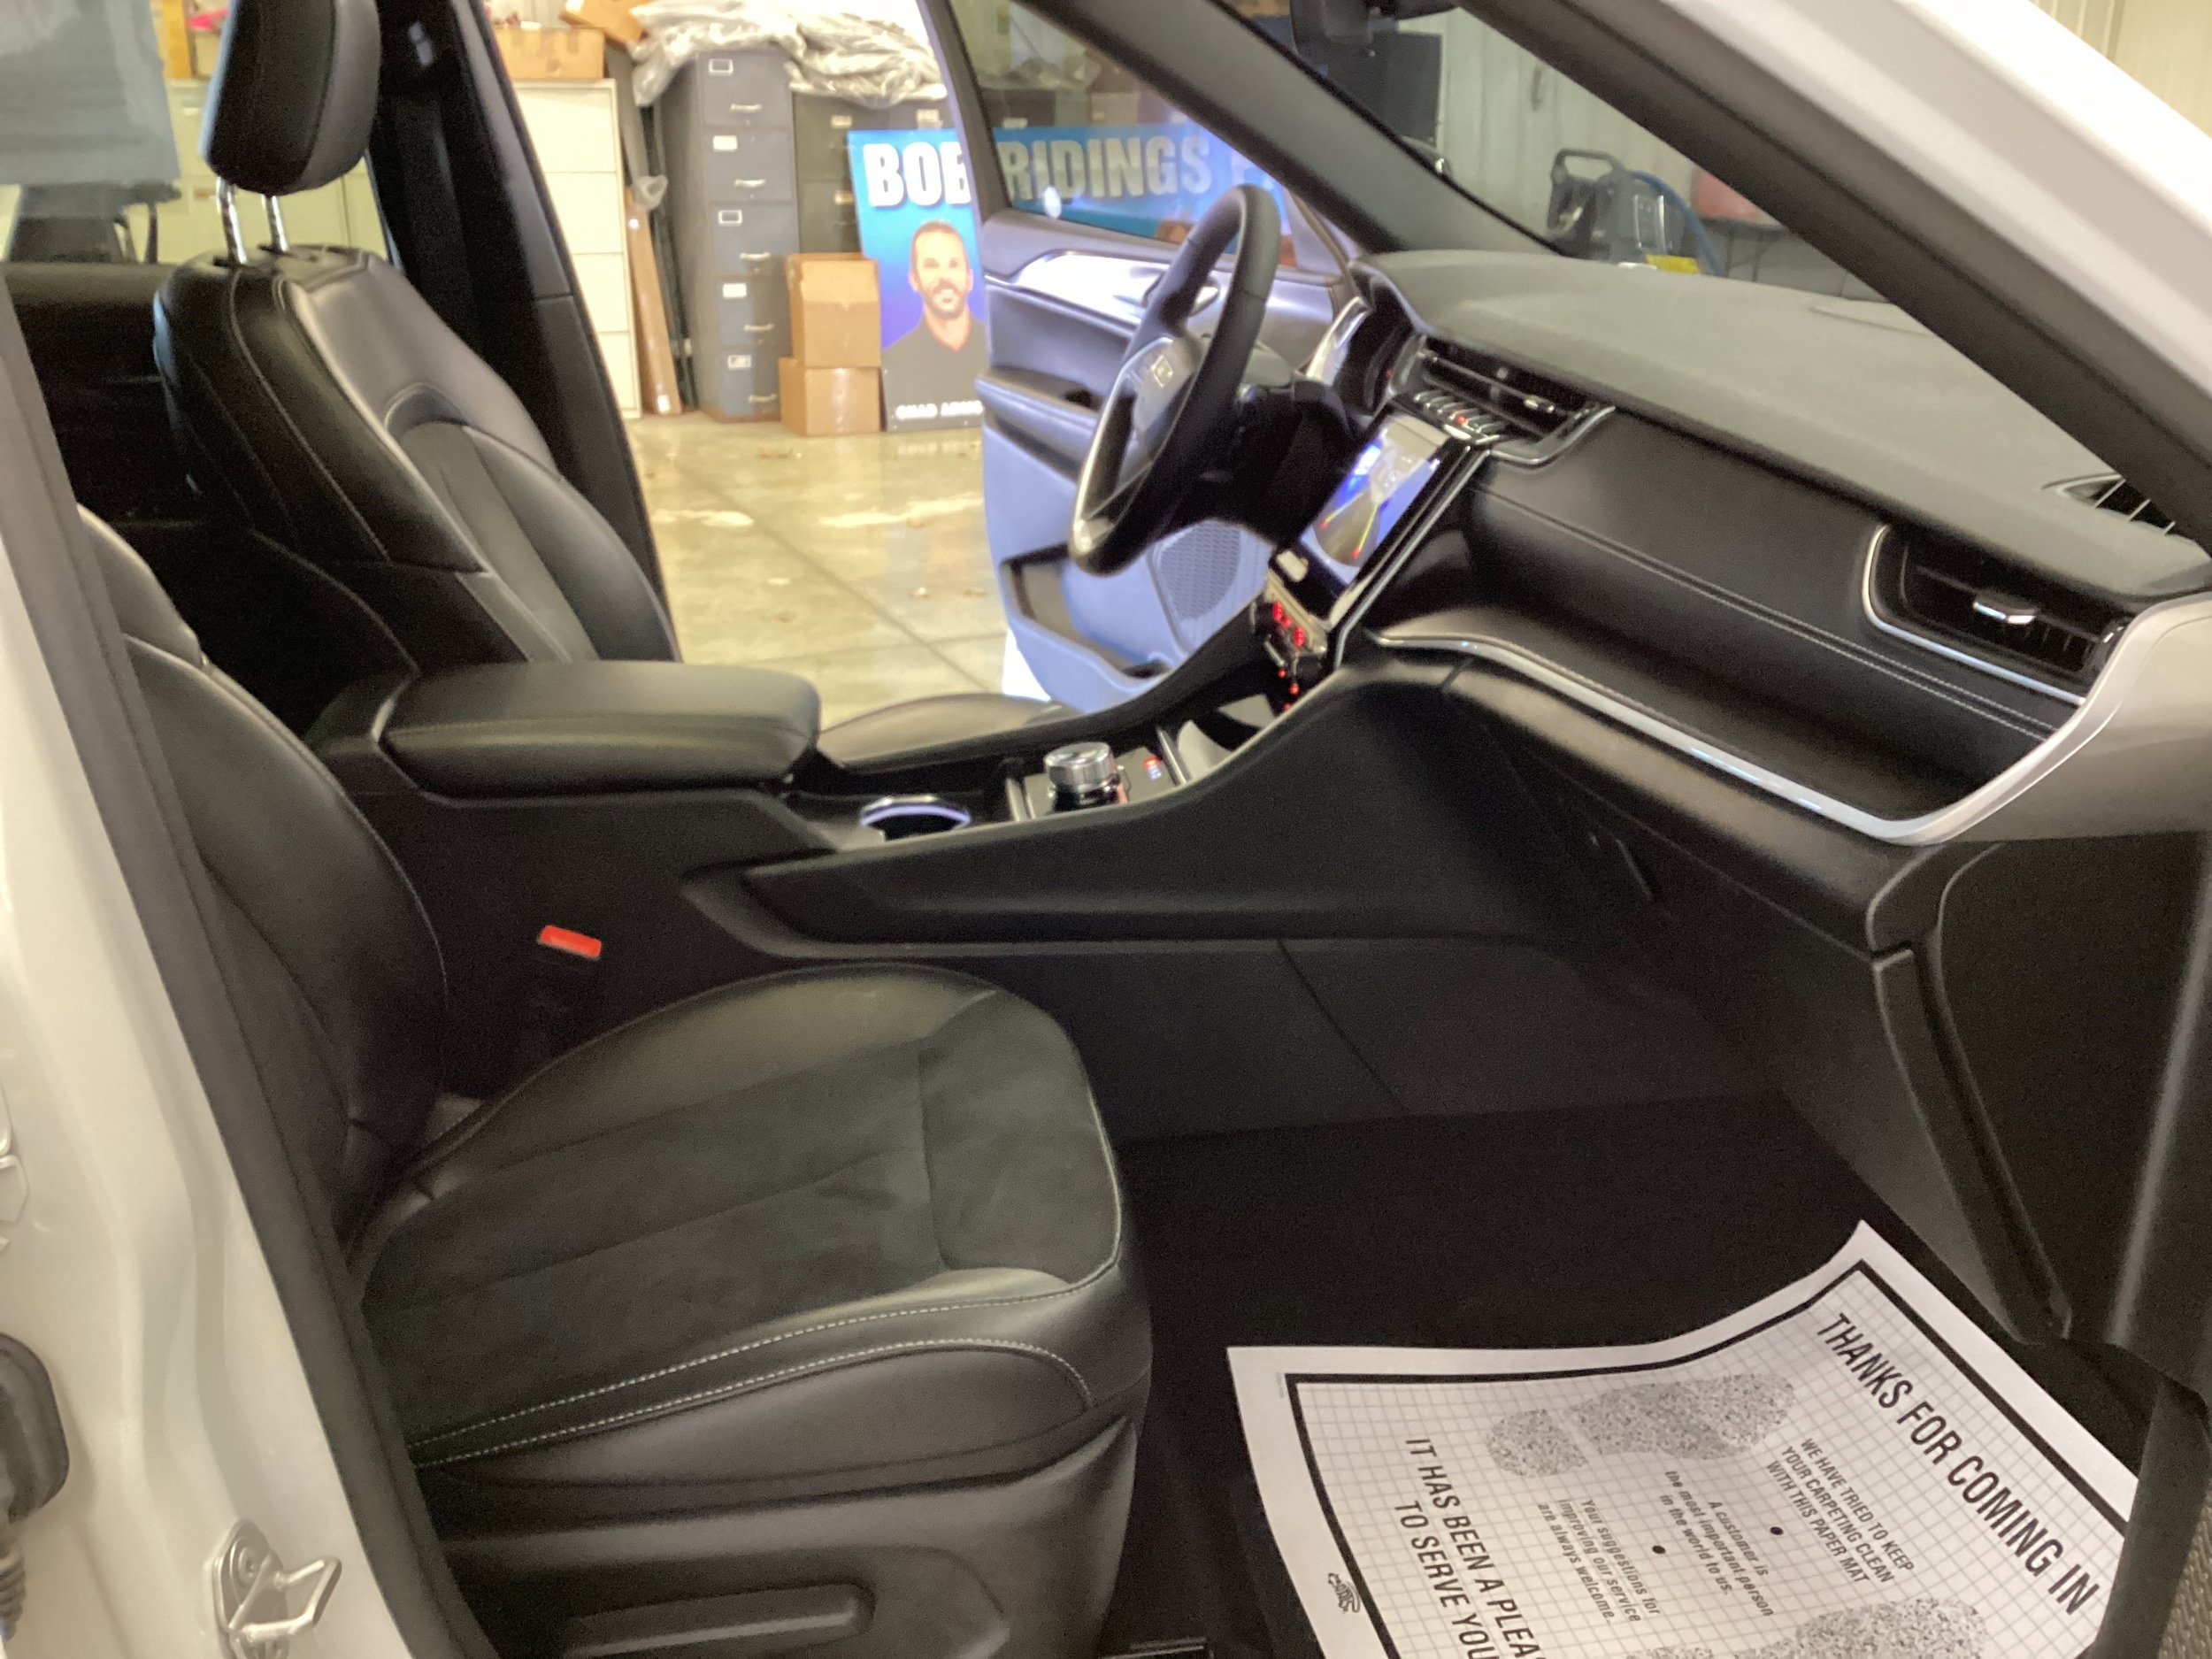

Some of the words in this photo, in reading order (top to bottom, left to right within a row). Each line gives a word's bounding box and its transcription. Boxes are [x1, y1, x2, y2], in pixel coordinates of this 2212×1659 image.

[862, 142, 972, 206] BOB
[997, 135, 1213, 201] RIDINGS
[1405, 1438, 1437, 1457] IT
[1816, 1311, 1914, 1409] THANKS
[1896, 1401, 1962, 1465] FOR
[1947, 1455, 2064, 1577] COMING
[2047, 1563, 2101, 1615] IN
[1394, 1500, 1429, 1529] TO
[1417, 1465, 1461, 1509] HAS
[1766, 1460, 1797, 1491] WITH
[1789, 1489, 1818, 1518] THIS
[1809, 1518, 1847, 1556] PAPER
[1839, 1556, 1870, 1583] MAT
[1781, 1446, 1812, 1479] YOUR
[1805, 1479, 1863, 1543] CARPETING
[1855, 1543, 1894, 1583] CLEAN
[1801, 1438, 1824, 1459] WE
[1815, 1456, 1847, 1490] HAVE
[1839, 1486, 1874, 1523] TRIED
[1868, 1522, 1889, 1540] TO
[1881, 1540, 1915, 1571] KEEP
[1442, 1515, 1496, 1571] BEEN
[1538, 1503, 1557, 1522] are
[1550, 1525, 1582, 1563] always
[1557, 1499, 1600, 1554] improving
[1593, 1557, 1613, 1576] our
[1606, 1578, 1641, 1622] service
[1580, 1500, 1603, 1524] Your
[1597, 1527, 1647, 1595] suggestions
[1642, 1598, 1661, 1614] for
[1659, 1494, 1674, 1505] in
[1668, 1509, 1687, 1525] the
[1683, 1528, 1715, 1560] world
[1706, 1563, 1720, 1574] to
[1664, 1471, 1683, 1487] the
[1679, 1491, 1706, 1517] most
[1699, 1520, 1746, 1573] important
[1734, 1576, 1774, 1617] person
[1715, 1511, 1760, 1562] customer
[1754, 1565, 1769, 1576] is
[1410, 1535, 1471, 1608] SERVE
[1474, 1578, 1505, 1593] A
[1452, 1613, 1500, 1659] YOU
[1486, 1598, 1546, 1659] PLEA
